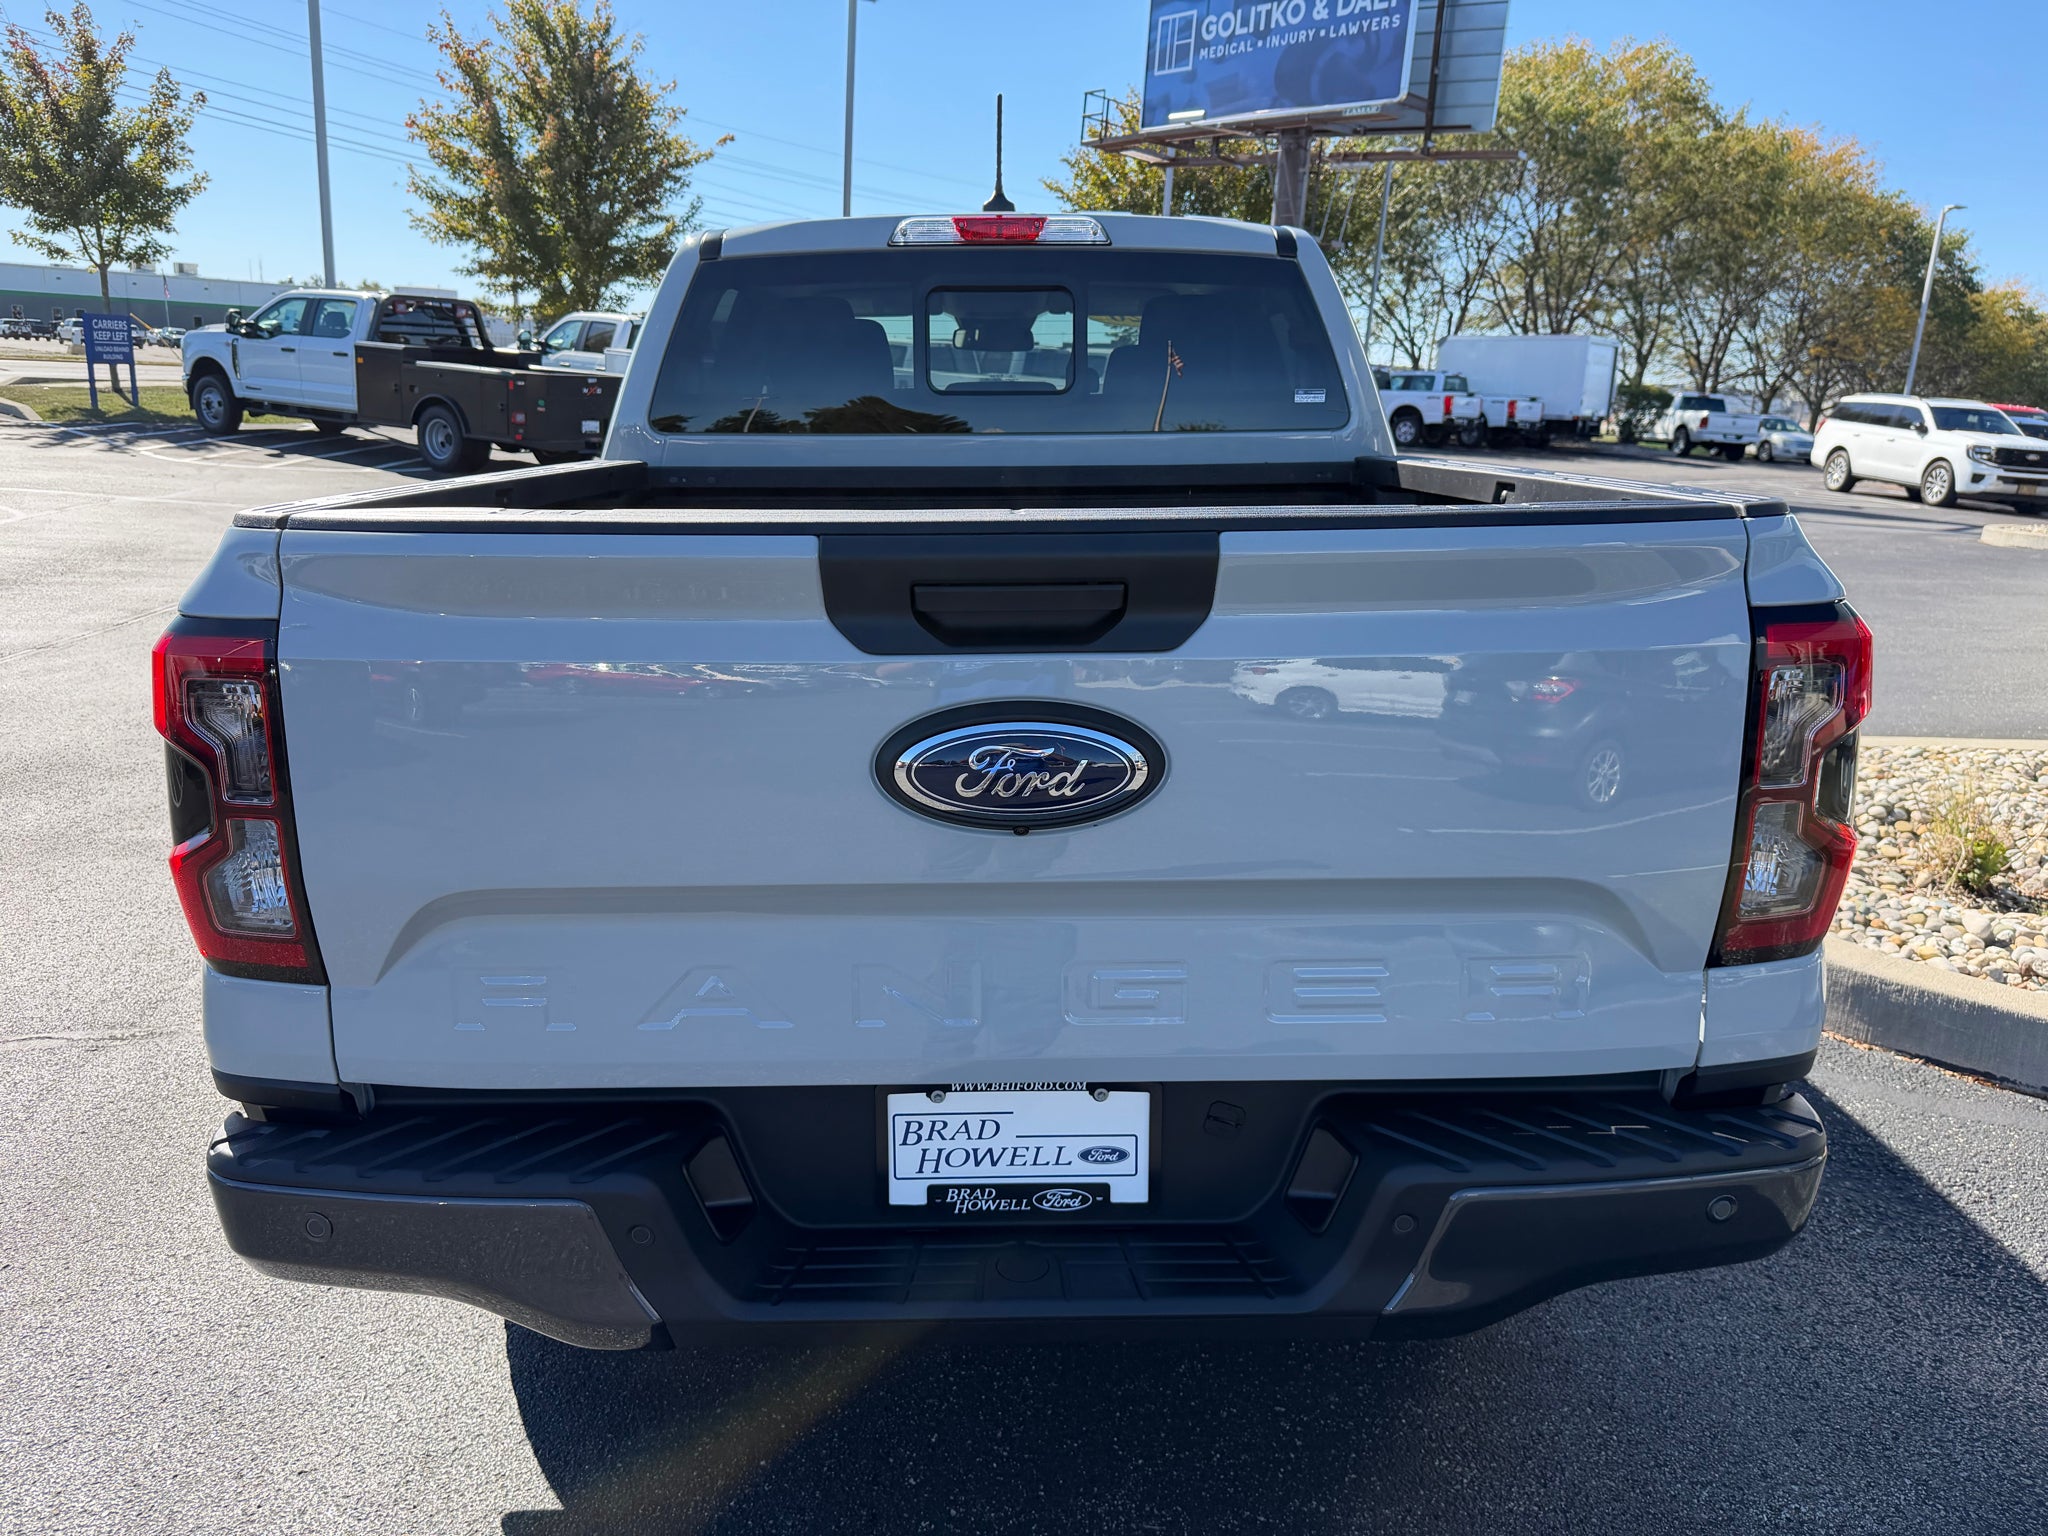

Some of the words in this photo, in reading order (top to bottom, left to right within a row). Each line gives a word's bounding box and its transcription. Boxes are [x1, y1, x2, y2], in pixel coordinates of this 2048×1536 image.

[1201, 0, 1306, 40] GOLITKO
[1312, 0, 1329, 20] &
[1199, 40, 1253, 60] MEDICAL
[1266, 28, 1316, 48] INJURY
[1329, 14, 1401, 38] LAWYERS
[92, 319, 128, 330] CARRIERS
[93, 330, 111, 341] KEEP
[112, 331, 128, 341] LEFT
[955, 745, 1089, 798] Ford
[452, 955, 1591, 1031] RANGER
[951, 1081, 1087, 1092] WWW.BHIFORD.COM
[899, 1119, 1001, 1147] BRAD
[915, 1145, 1073, 1174] HOWELL
[1087, 1147, 1119, 1163] Ford
[946, 1188, 996, 1202] BRAD
[954, 1199, 1031, 1214] HOWELL
[1043, 1191, 1082, 1208] Ford
